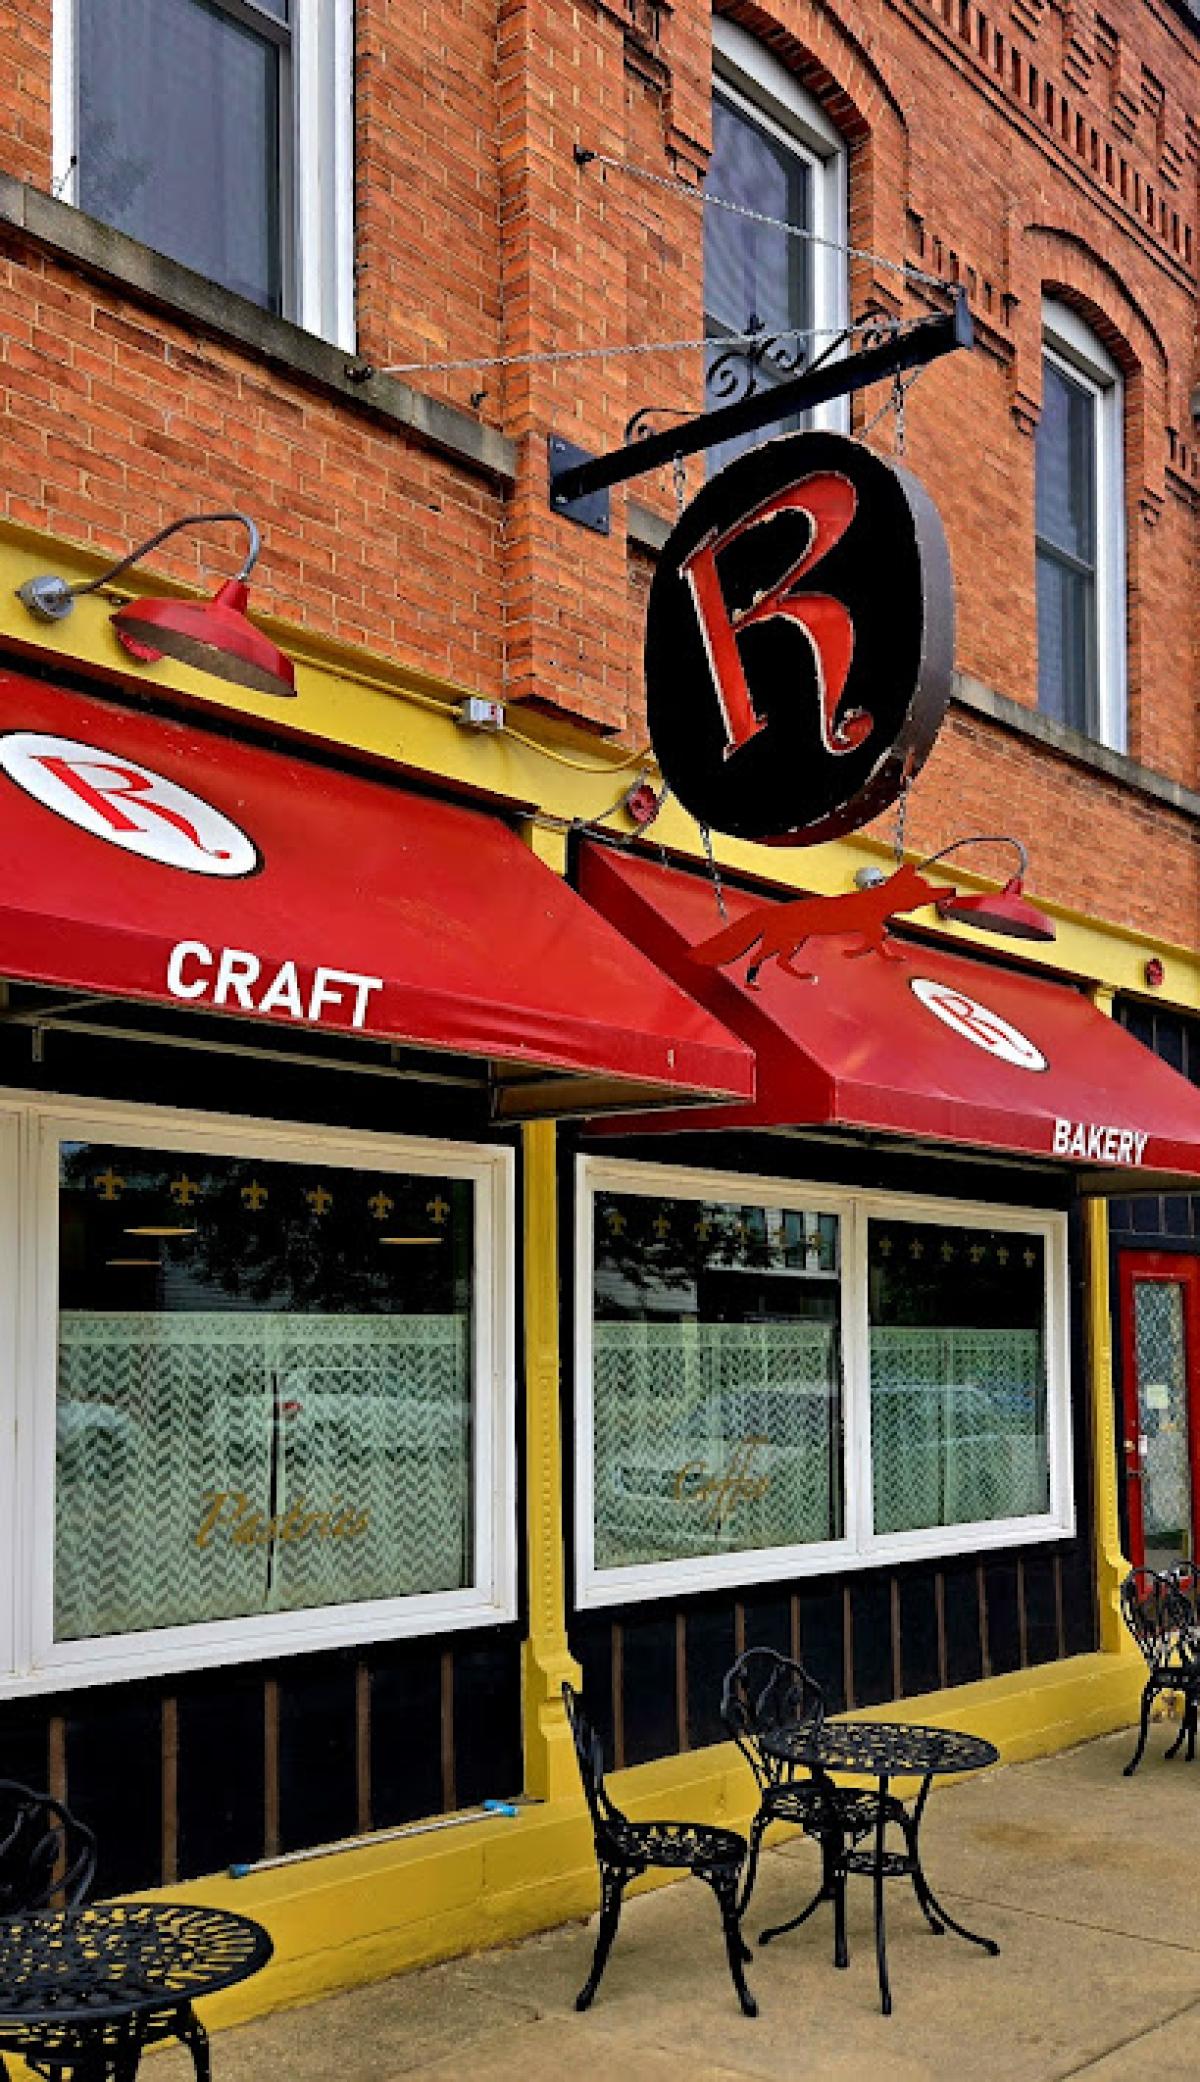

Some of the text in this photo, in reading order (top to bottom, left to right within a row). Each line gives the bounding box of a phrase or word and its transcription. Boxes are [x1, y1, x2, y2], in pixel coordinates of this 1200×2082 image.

[679, 471, 873, 761] R
[30, 755, 232, 859] R
[166, 940, 383, 1027] CRAFT
[1053, 1118, 1148, 1165] BAKERY
